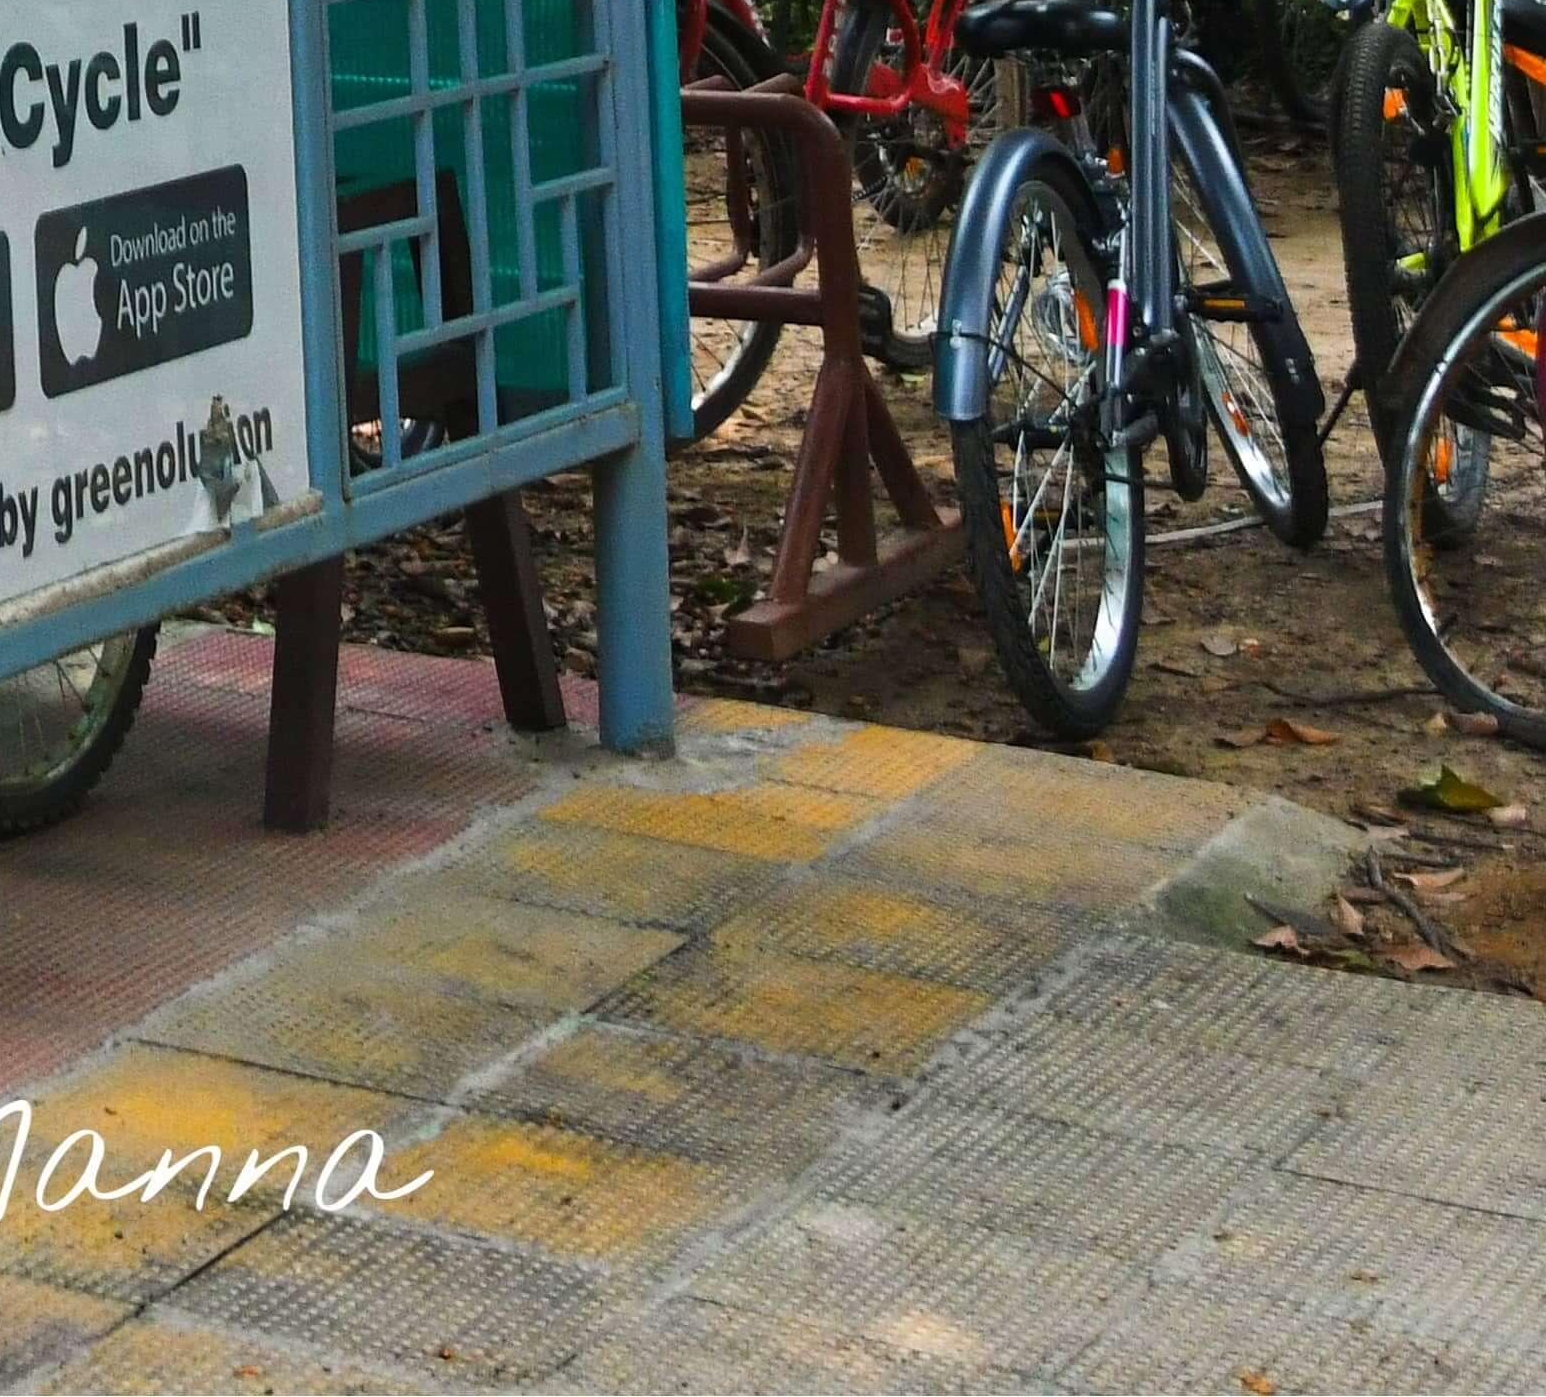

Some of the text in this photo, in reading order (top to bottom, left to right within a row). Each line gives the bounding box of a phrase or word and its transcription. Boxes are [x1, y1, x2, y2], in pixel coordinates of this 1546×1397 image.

[110, 205, 236, 268] Download on the
[117, 261, 235, 339] App Store
[51, 404, 273, 544] greenoluion
